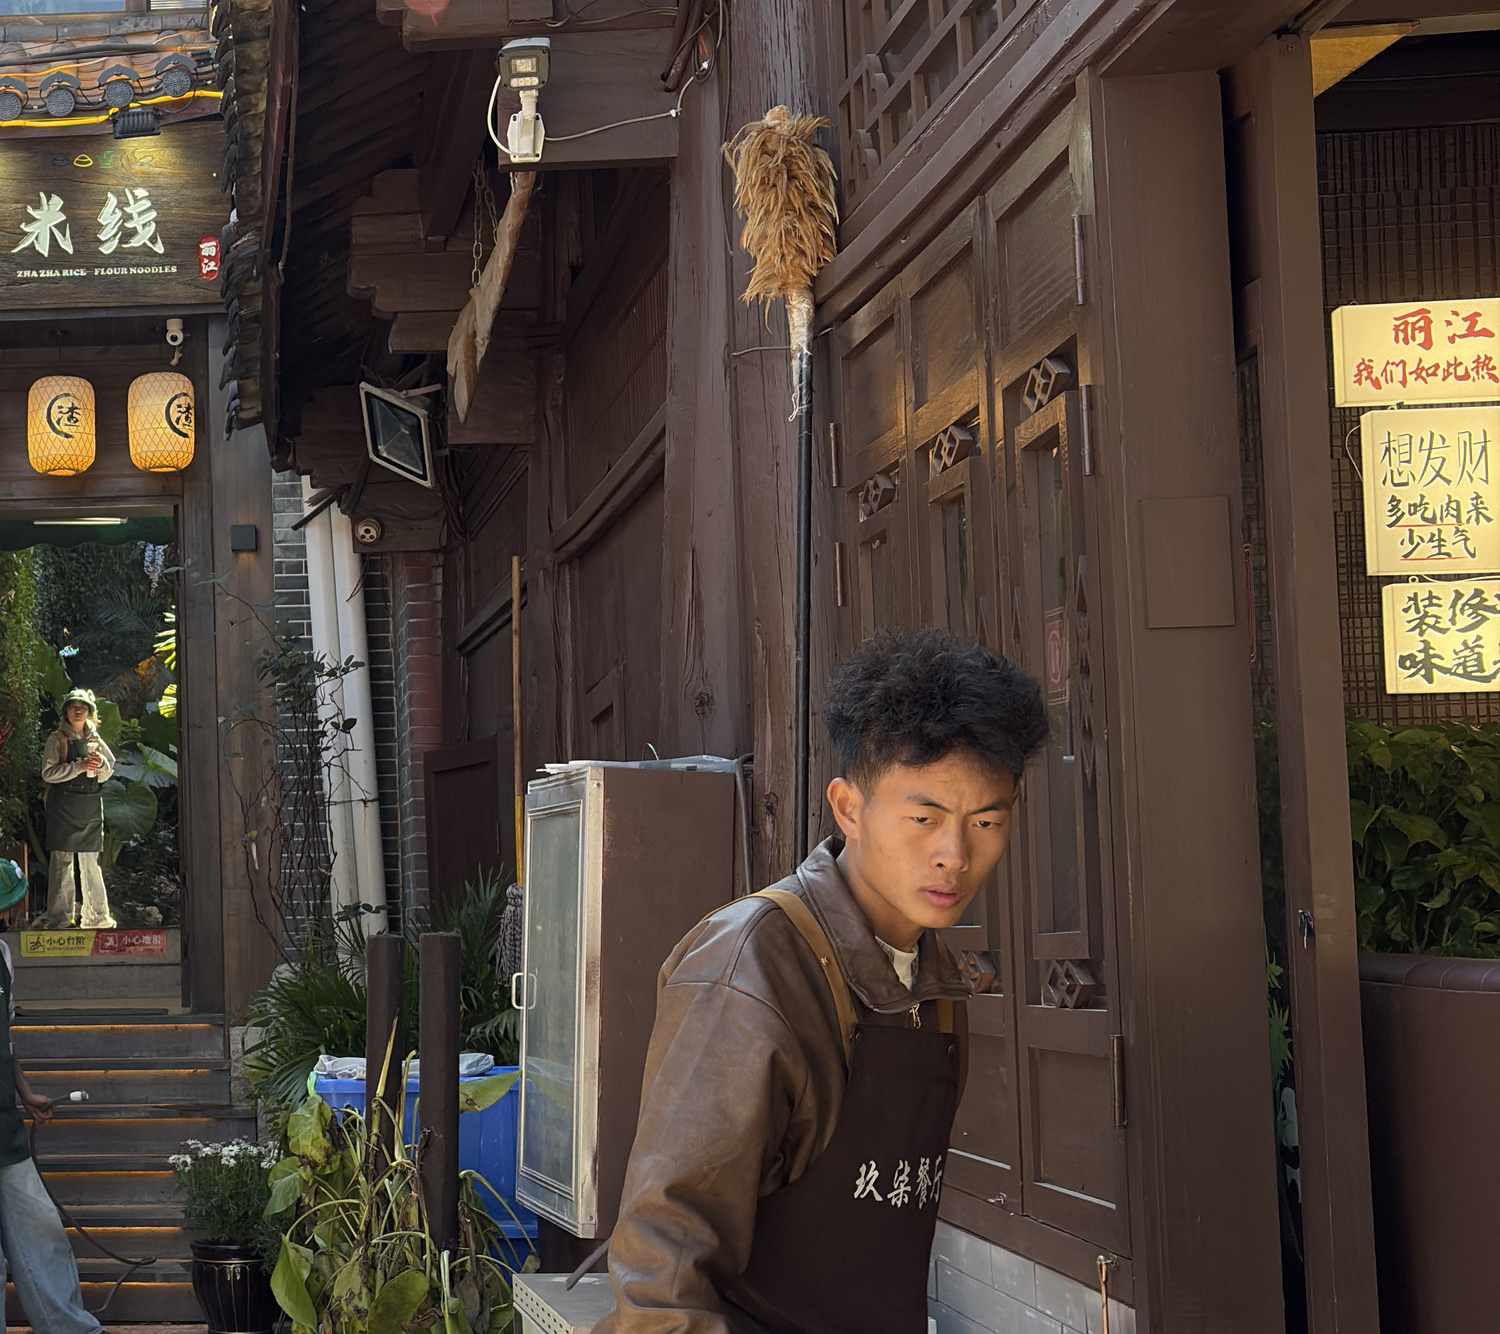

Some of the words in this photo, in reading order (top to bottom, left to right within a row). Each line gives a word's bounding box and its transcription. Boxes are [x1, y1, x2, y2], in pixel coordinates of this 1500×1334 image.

[17, 270, 38, 278] ZHA
[39, 269, 61, 277] ZHA
[94, 267, 128, 275] FLOUR
[130, 265, 177, 274] NOODLES
[199, 242, 218, 274] 丽江
[1393, 308, 1495, 351] 丽江
[1353, 354, 1500, 390] 我们如此热
[55, 402, 80, 427] 渣
[1380, 428, 1491, 487] 想发财
[1386, 491, 1494, 528] 多吃肉来
[1400, 526, 1476, 559] 少生气
[1402, 587, 1500, 638] 装修
[1398, 634, 1500, 685] 味道
